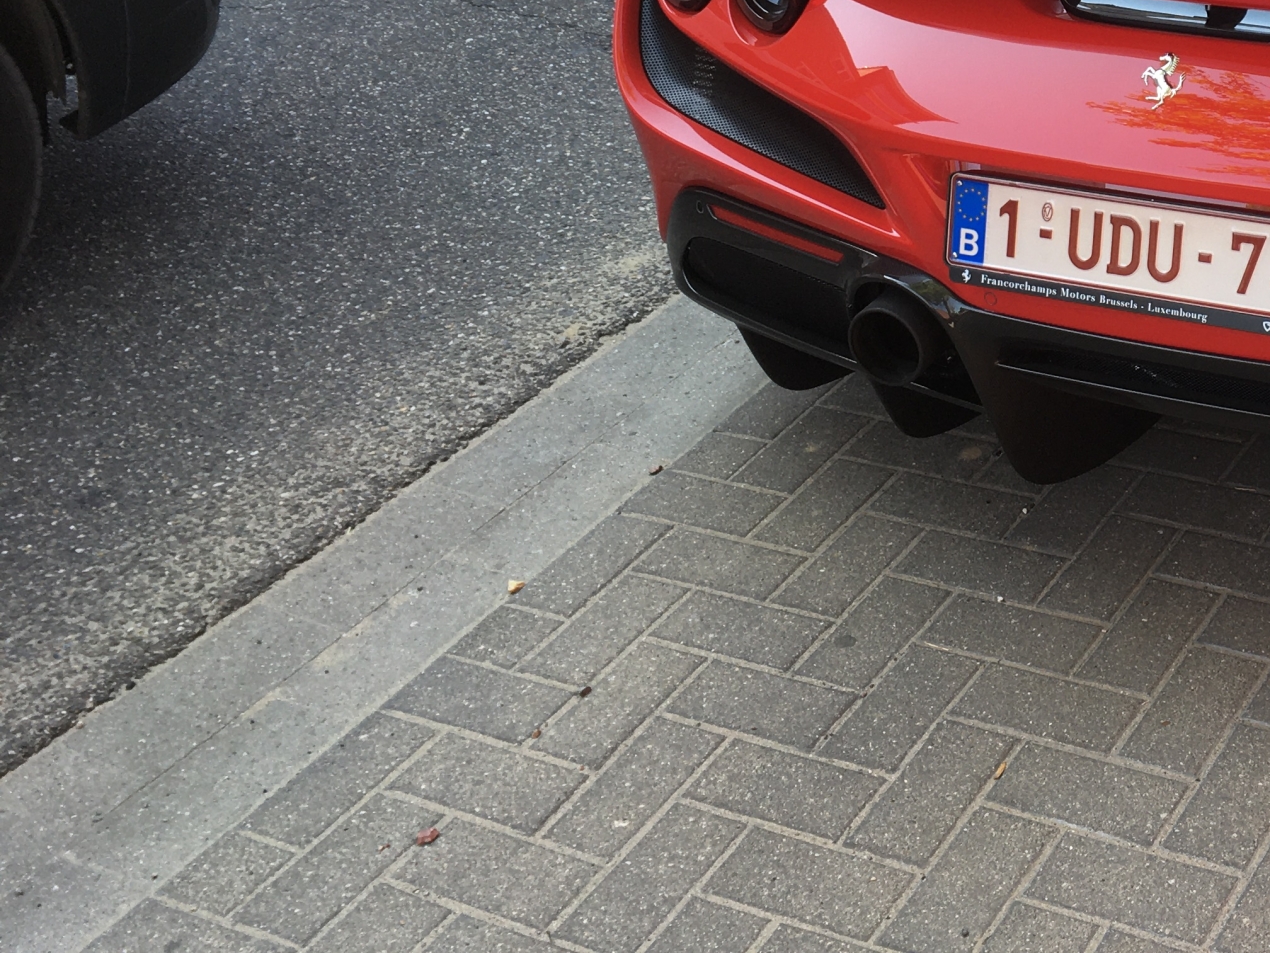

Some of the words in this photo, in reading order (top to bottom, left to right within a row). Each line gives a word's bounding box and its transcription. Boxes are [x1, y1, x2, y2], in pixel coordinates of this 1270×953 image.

[958, 228, 980, 257] B
[980, 274, 1058, 297] Francorchamps
[1060, 287, 1096, 303] Motors
[1099, 294, 1139, 310] Brussels
[1147, 303, 1209, 324] Luxembourg
